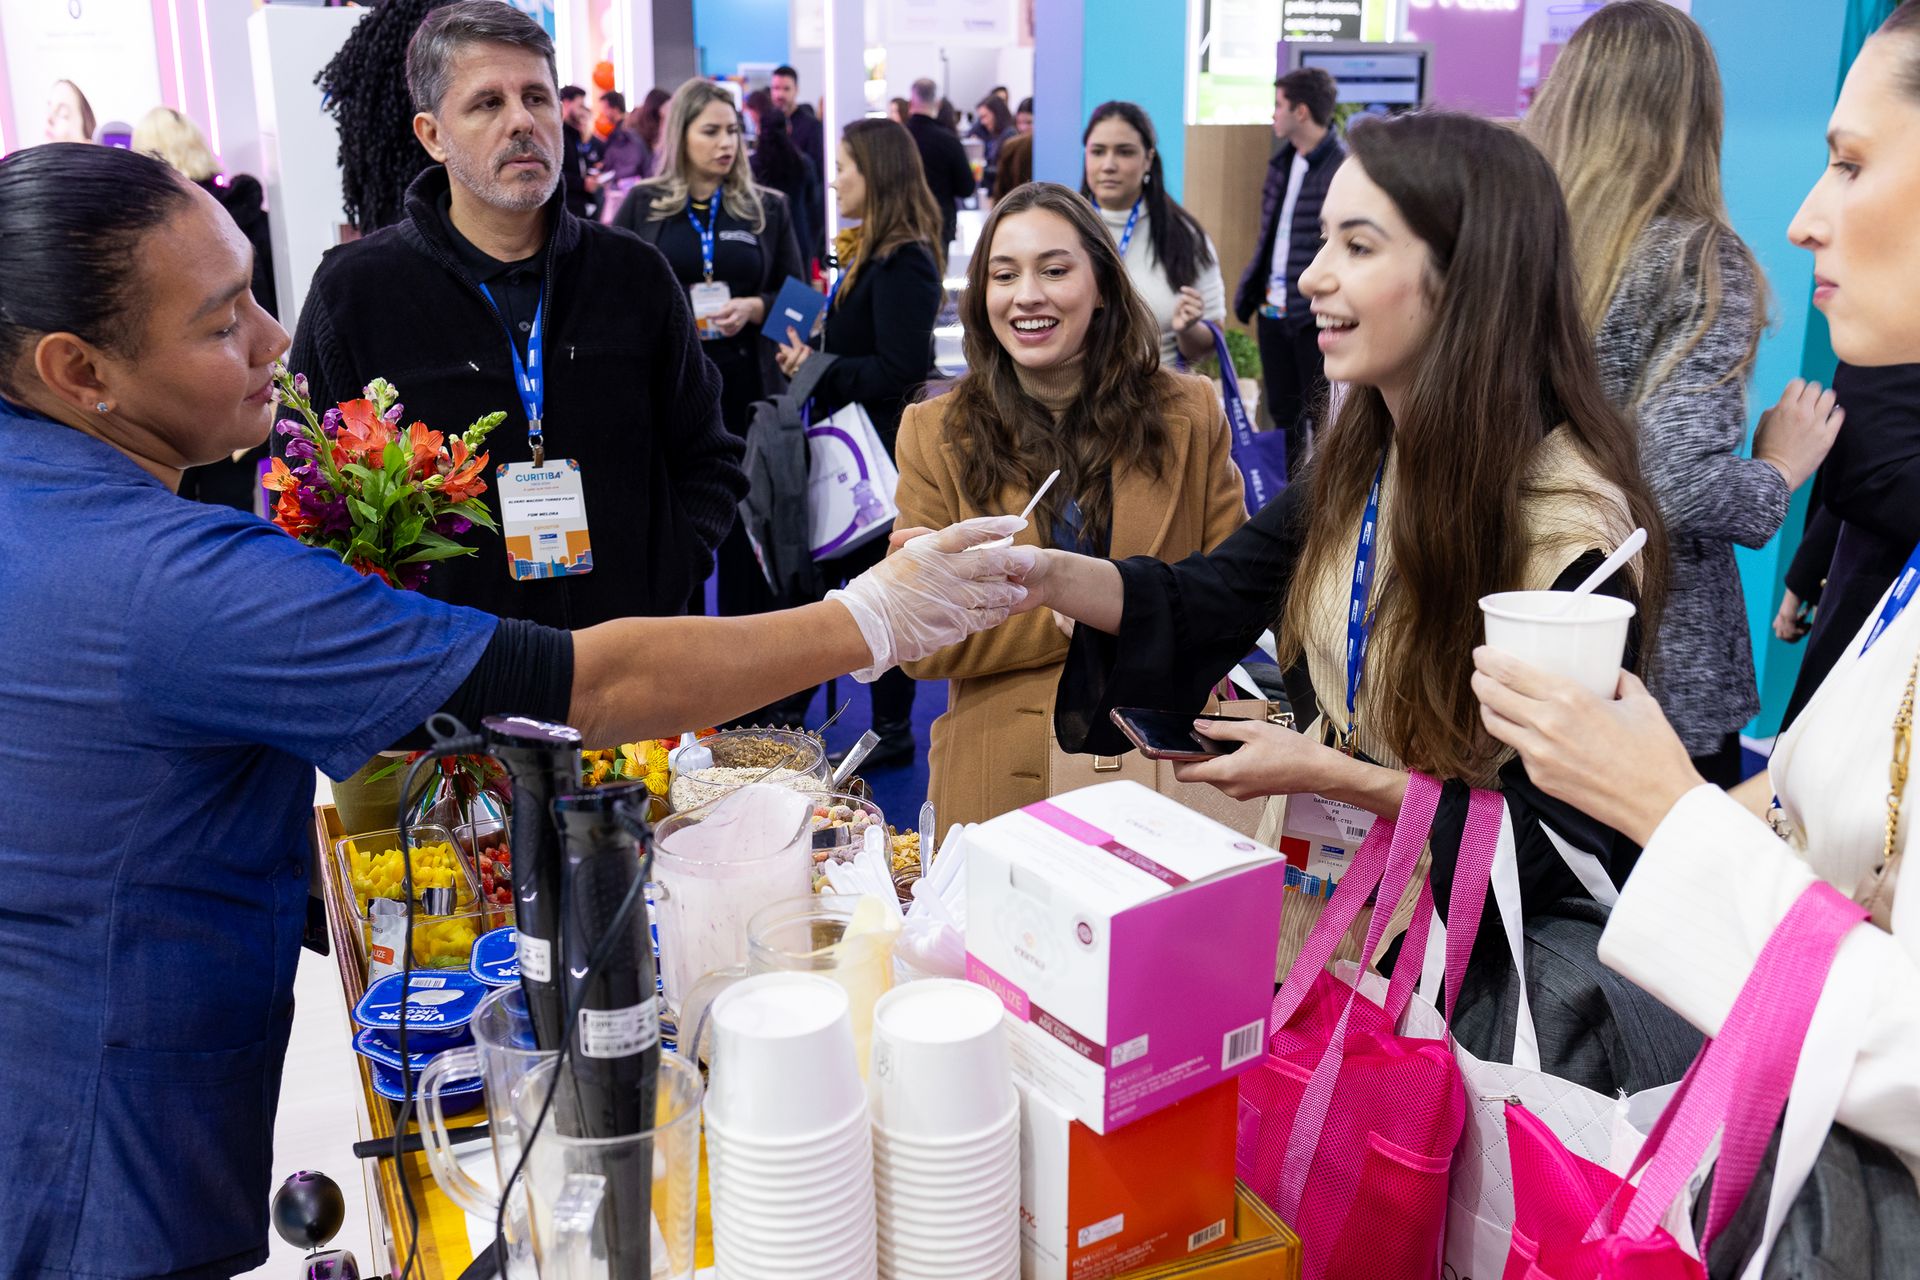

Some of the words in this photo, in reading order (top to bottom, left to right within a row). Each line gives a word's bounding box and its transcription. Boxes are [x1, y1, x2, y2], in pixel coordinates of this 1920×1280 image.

[515, 471, 561, 482] CURITIBA
[1313, 798, 1341, 807] GABRIELA
[378, 1012, 445, 1022] VIGOR
